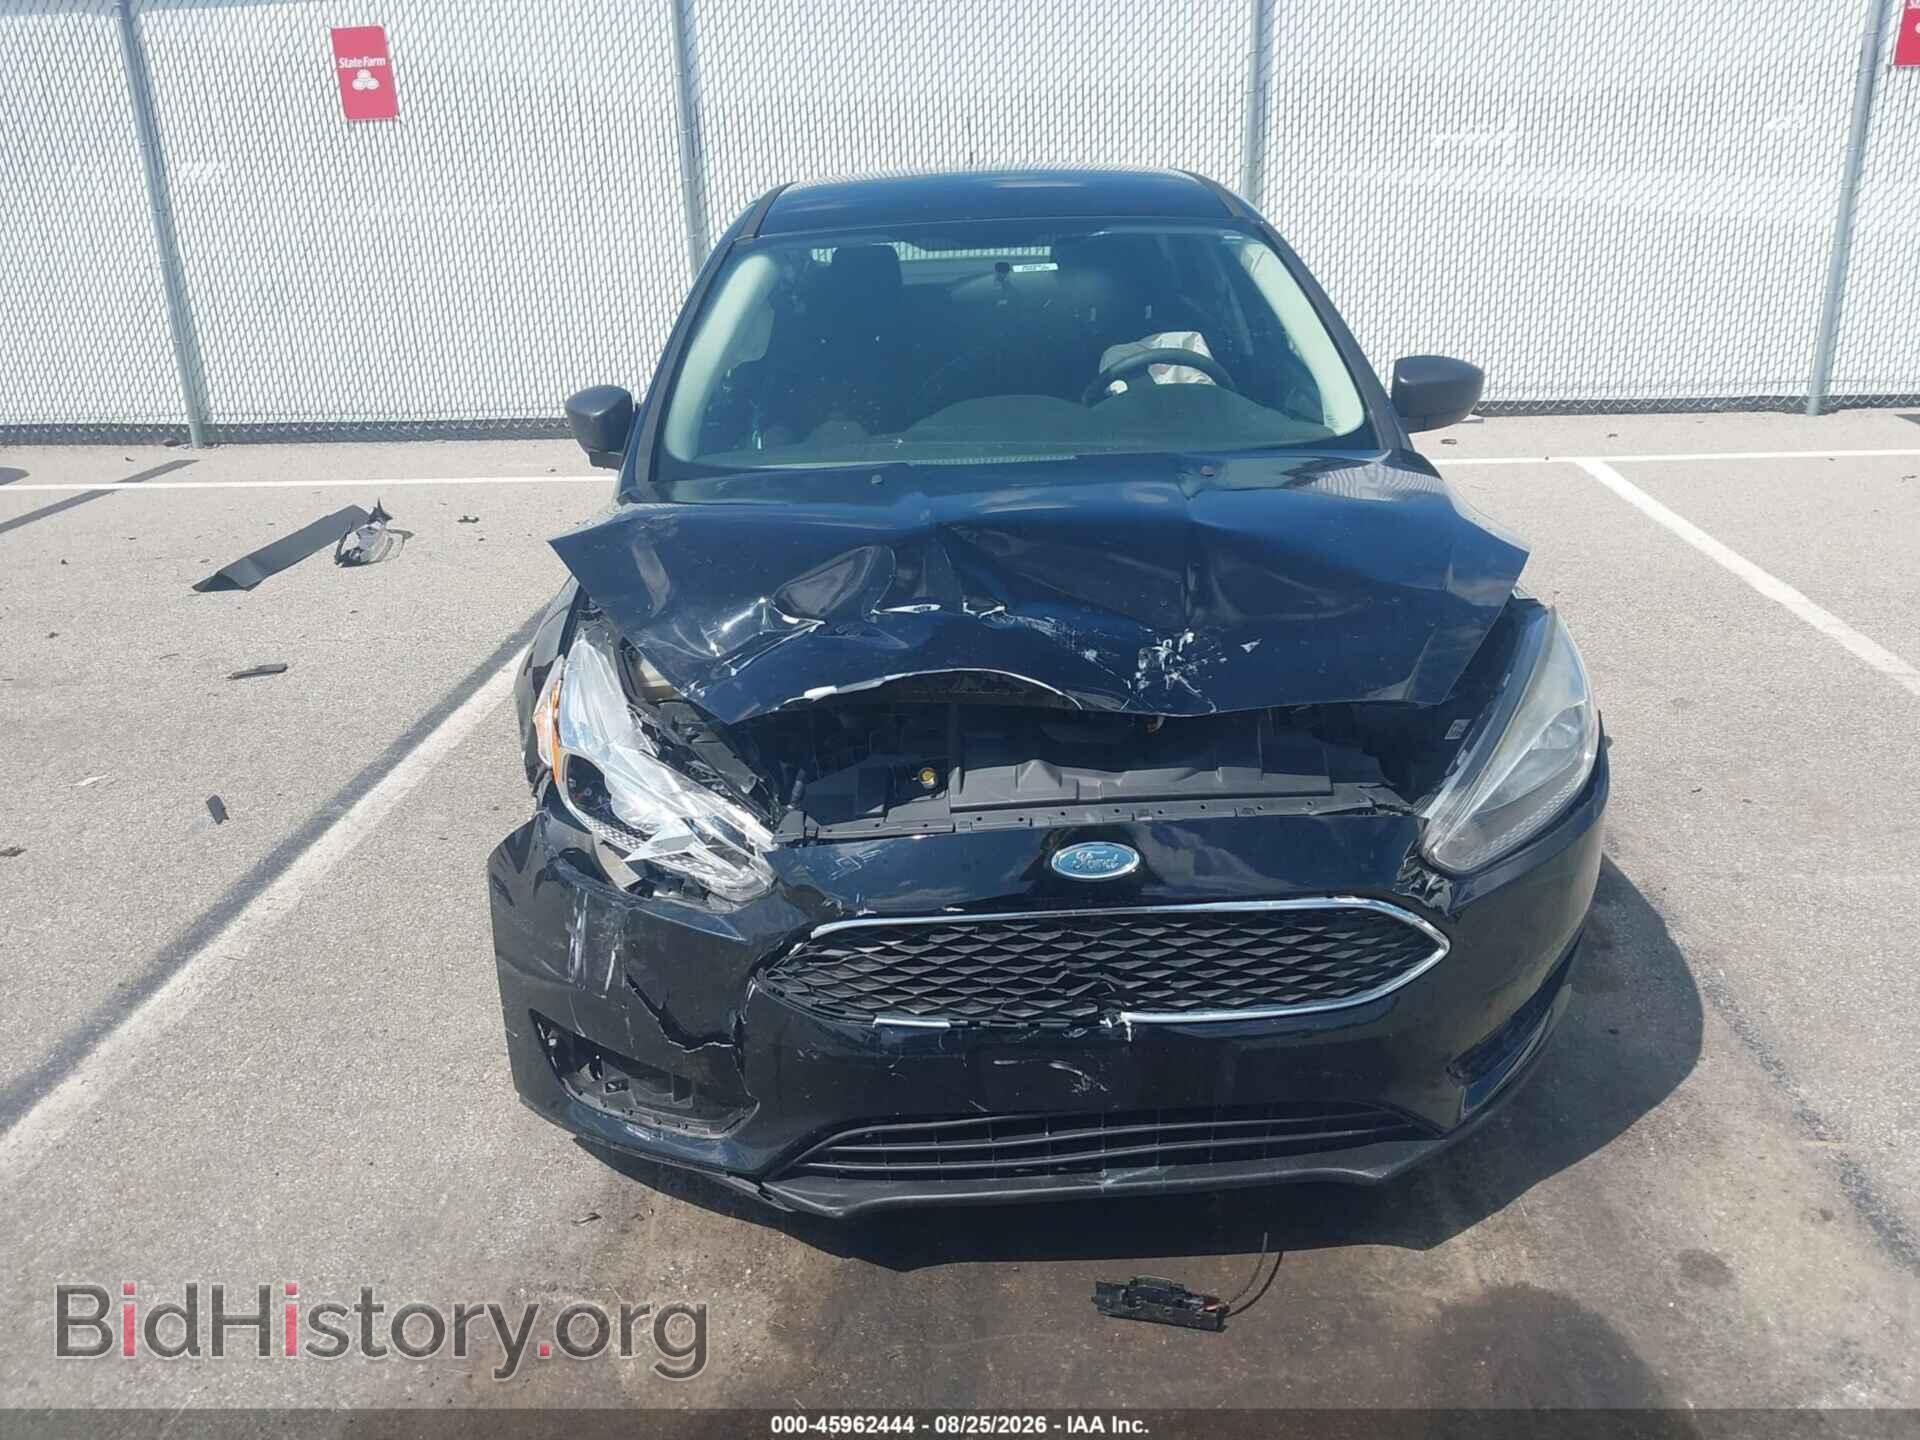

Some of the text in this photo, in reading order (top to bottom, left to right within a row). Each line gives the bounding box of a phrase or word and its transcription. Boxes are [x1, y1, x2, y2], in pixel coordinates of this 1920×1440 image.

[338, 56, 386, 68] State Farm
[1072, 848, 1120, 871] Ford
